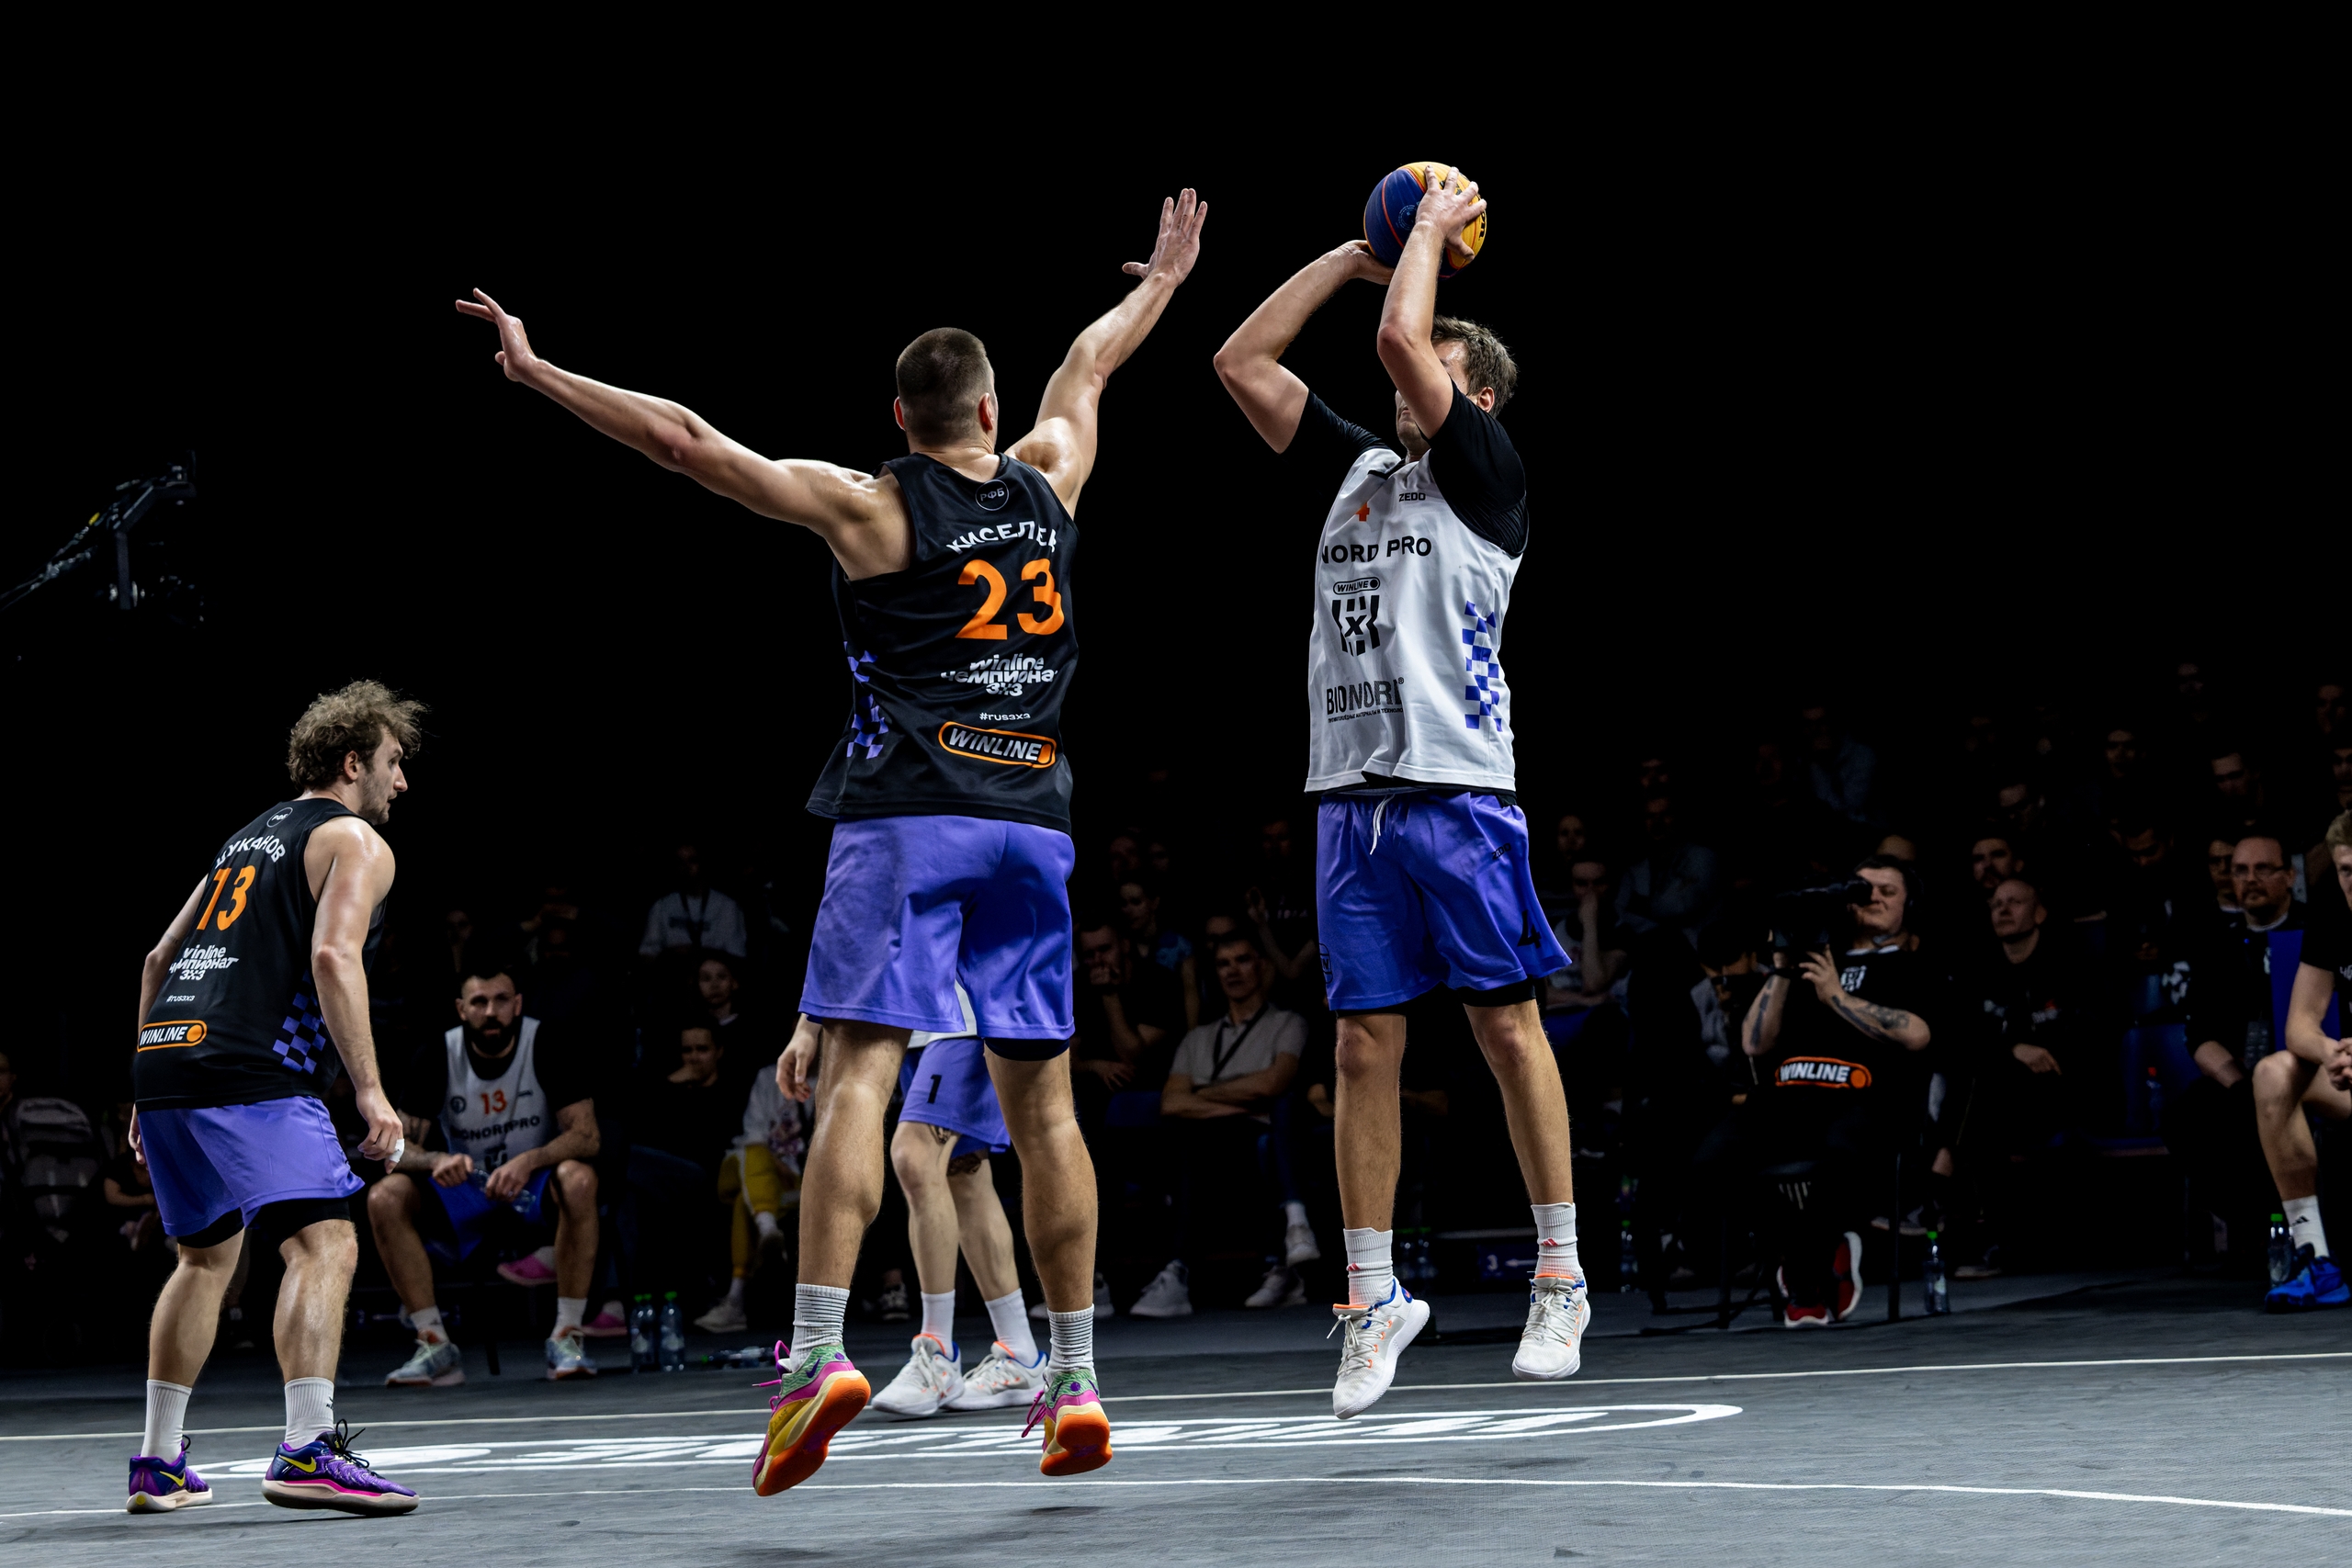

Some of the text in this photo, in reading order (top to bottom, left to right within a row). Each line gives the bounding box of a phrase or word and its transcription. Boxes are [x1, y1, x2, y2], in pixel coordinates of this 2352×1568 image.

[980, 488, 1005, 502] РФБ
[1386, 536, 1431, 558] PRO
[955, 558, 1065, 640] 23
[969, 653, 1045, 671] winline
[940, 670, 1058, 684] чемпиона
[949, 728, 1043, 761] WINLINE
[197, 865, 256, 931] 13
[1517, 909, 1542, 950] 4
[140, 1026, 188, 1046] WINLINE
[1779, 1062, 1851, 1083] WINLINE
[927, 1075, 942, 1104] 1
[481, 1090, 507, 1114] 13
